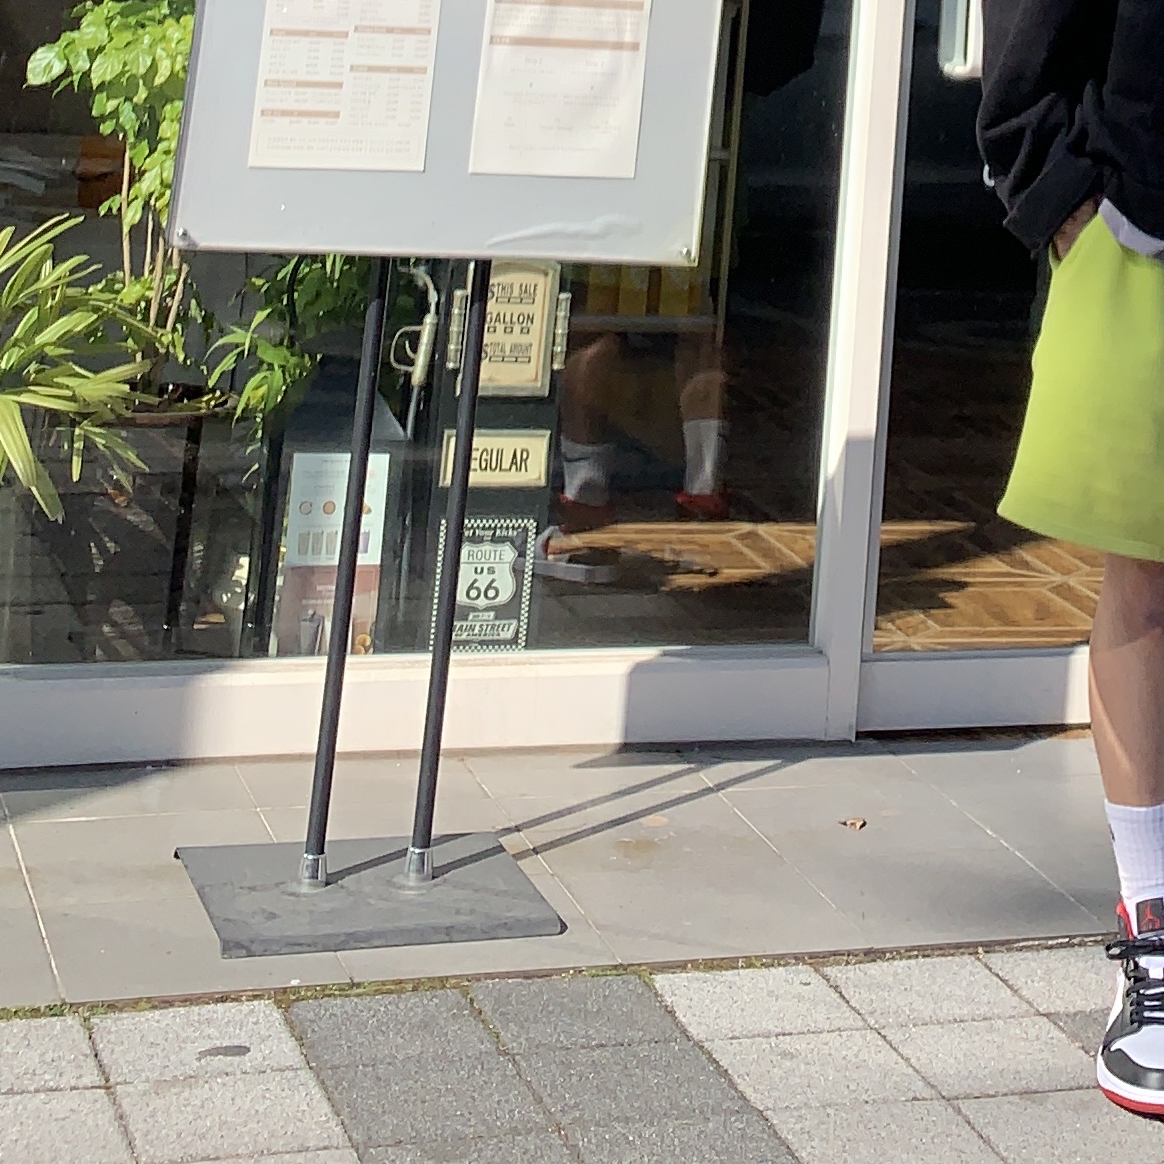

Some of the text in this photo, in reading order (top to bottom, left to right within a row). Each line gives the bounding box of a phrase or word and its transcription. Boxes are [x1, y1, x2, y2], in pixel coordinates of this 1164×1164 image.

[496, 282, 514, 295] THIS
[519, 283, 538, 297] SALE
[471, 447, 530, 472] EGULAR
[467, 549, 506, 561] ROUTE
[474, 566, 496, 575] US
[465, 578, 500, 601] 66
[455, 622, 514, 633] AIN STREET
